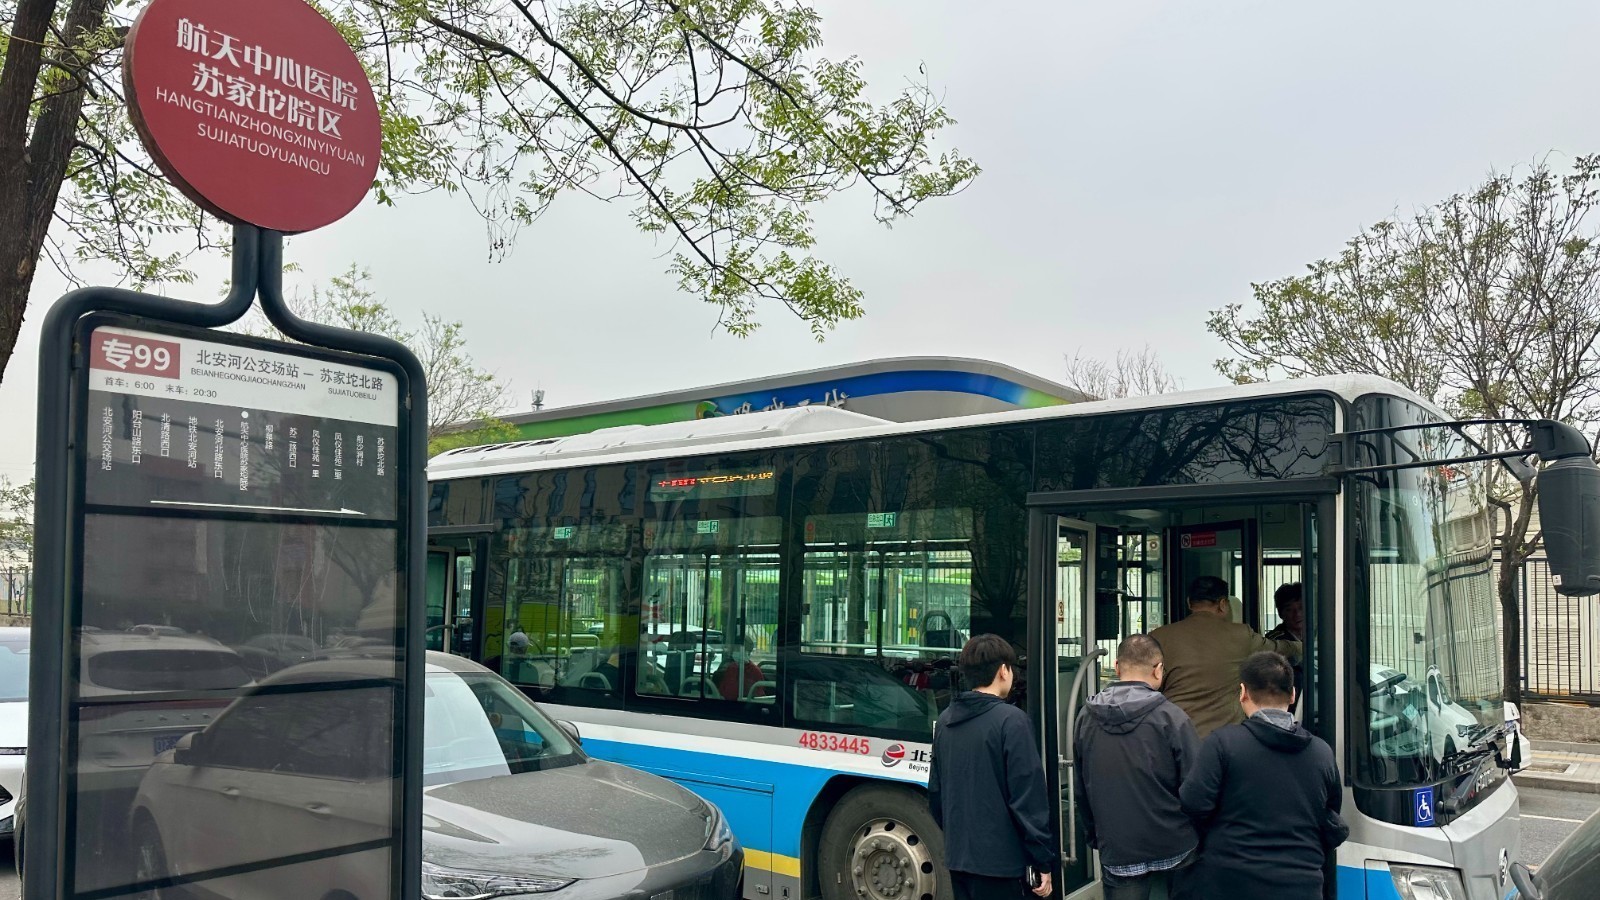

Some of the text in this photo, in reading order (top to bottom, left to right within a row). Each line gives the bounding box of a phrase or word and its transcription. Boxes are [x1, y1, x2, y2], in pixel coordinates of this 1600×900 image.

[176, 18, 358, 111] 航天中心医院
[156, 86, 365, 167] HANGTIANZHONGXINYIYUAN
[191, 62, 343, 140] 苏家坨院区
[197, 123, 330, 176] SUJIATUOYUANQU
[101, 338, 171, 371] 专99
[196, 349, 300, 379] 北安河公交场站
[320, 368, 384, 392] 苏家坨北路
[190, 367, 377, 400] BEIANHEGONGJIAOCHANGZHAN SUJIATUOBEILU
[193, 388, 217, 399] 20:30
[101, 406, 113, 471] 北安河公交场站
[131, 409, 143, 464] 阳台山路东口
[160, 412, 171, 457] 北清路西口
[187, 415, 198, 469] 地铁北安河站
[213, 418, 224, 479] 北安河北路东口
[798, 732, 870, 755] 4833445
[908, 763, 929, 772] Beijing
